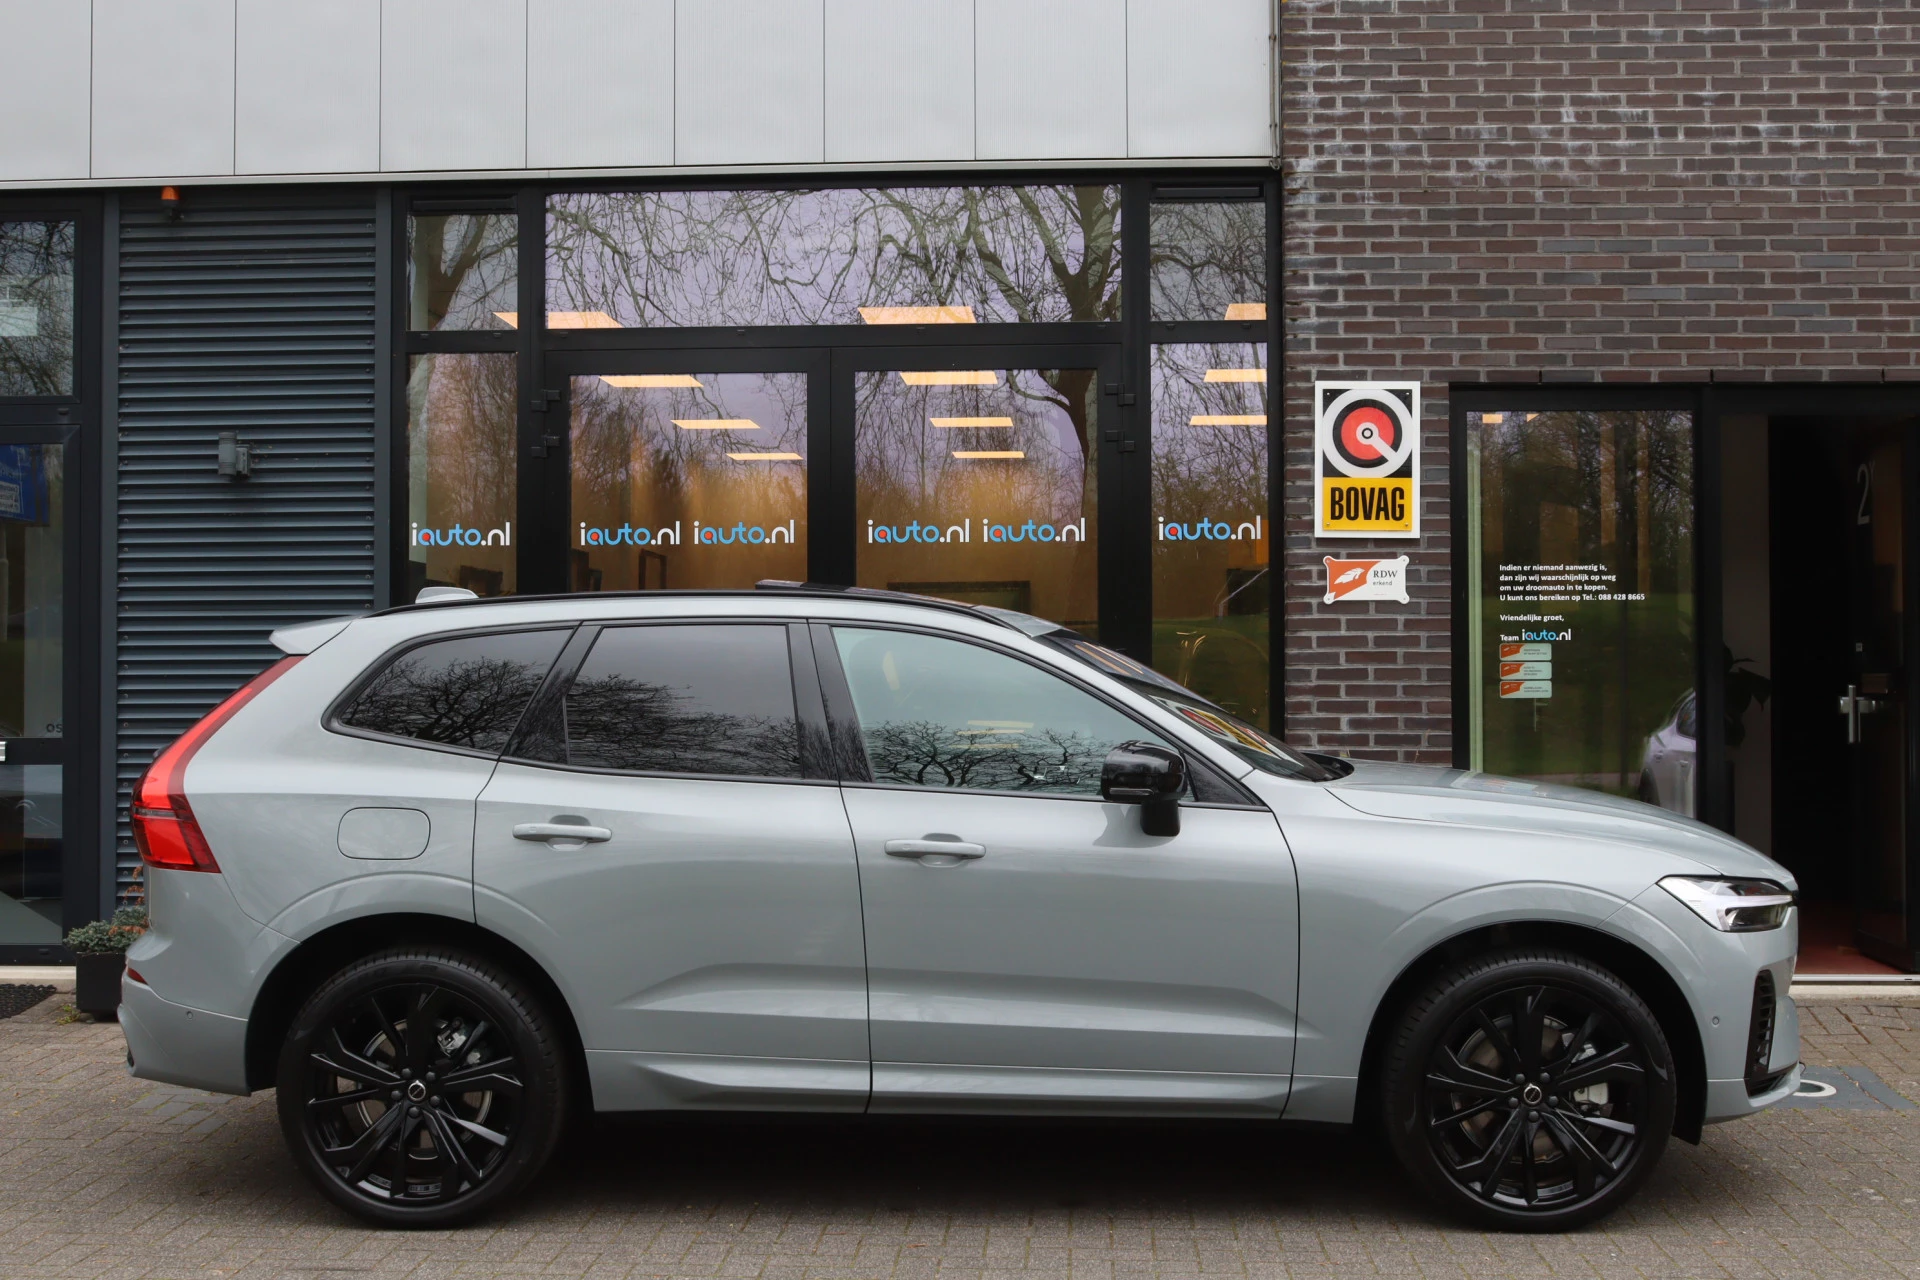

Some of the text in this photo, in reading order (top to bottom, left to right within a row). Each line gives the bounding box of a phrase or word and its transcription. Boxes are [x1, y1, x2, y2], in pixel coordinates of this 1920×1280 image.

[1330, 486, 1405, 522] BOVAG
[412, 522, 510, 546] iauto.nl
[581, 521, 680, 545] iauto.nl
[694, 520, 794, 544] iauto.nl
[868, 519, 970, 543] iauto.nl
[983, 518, 1085, 542] iauto.nl
[1158, 515, 1261, 540] iauto.nl
[1373, 570, 1398, 578] RDW
[1514, 574, 1527, 582] zijn
[1528, 574, 1540, 582] wij
[1541, 574, 1589, 582] waarschijnlijk
[1565, 564, 1598, 572] aanwezig
[1599, 564, 1608, 572] is,
[1584, 584, 1608, 592] kopen.
[1500, 614, 1565, 622] Vriendelijke groet,
[1521, 628, 1572, 641] iauto.nl
